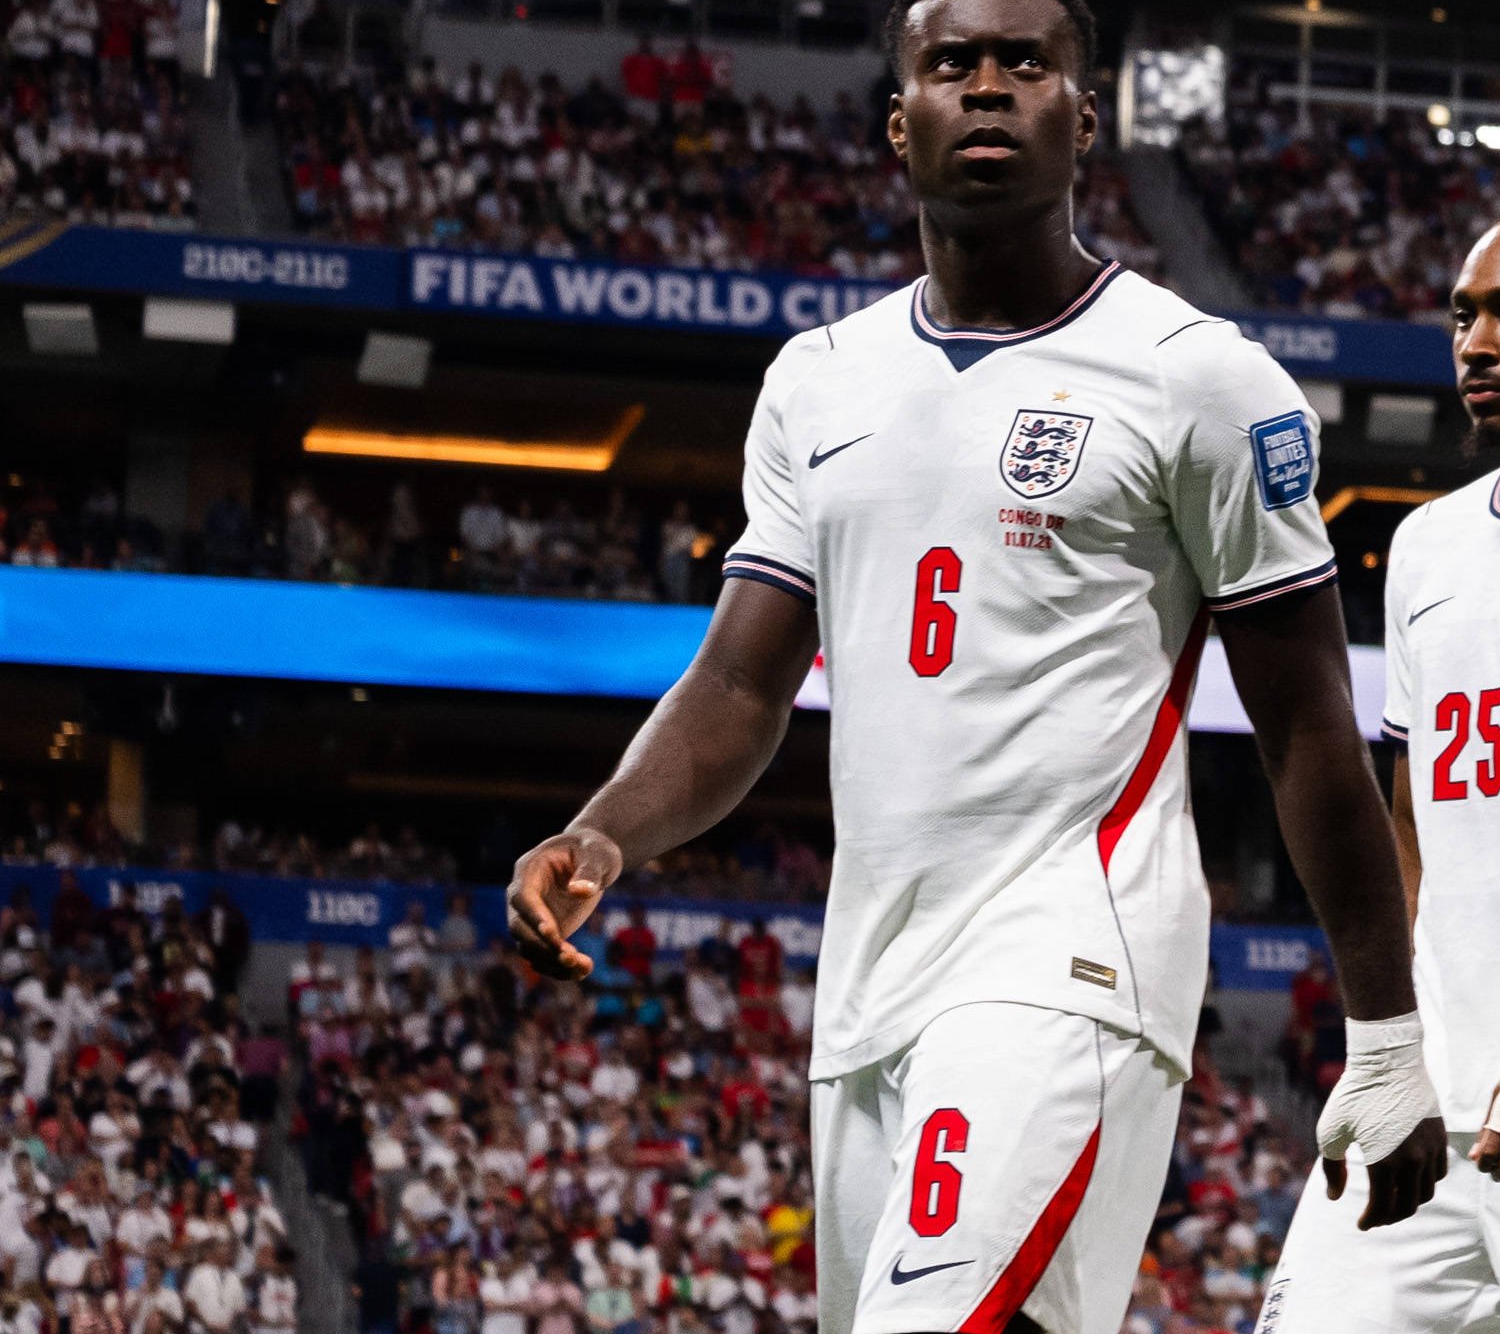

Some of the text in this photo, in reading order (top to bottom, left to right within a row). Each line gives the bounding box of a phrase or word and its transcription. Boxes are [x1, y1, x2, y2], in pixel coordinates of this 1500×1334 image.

[411, 251, 892, 330] FIFA WORLD CU
[998, 507, 1067, 530] CONGO DR
[907, 545, 963, 679] 6
[907, 1107, 971, 1238] 6
